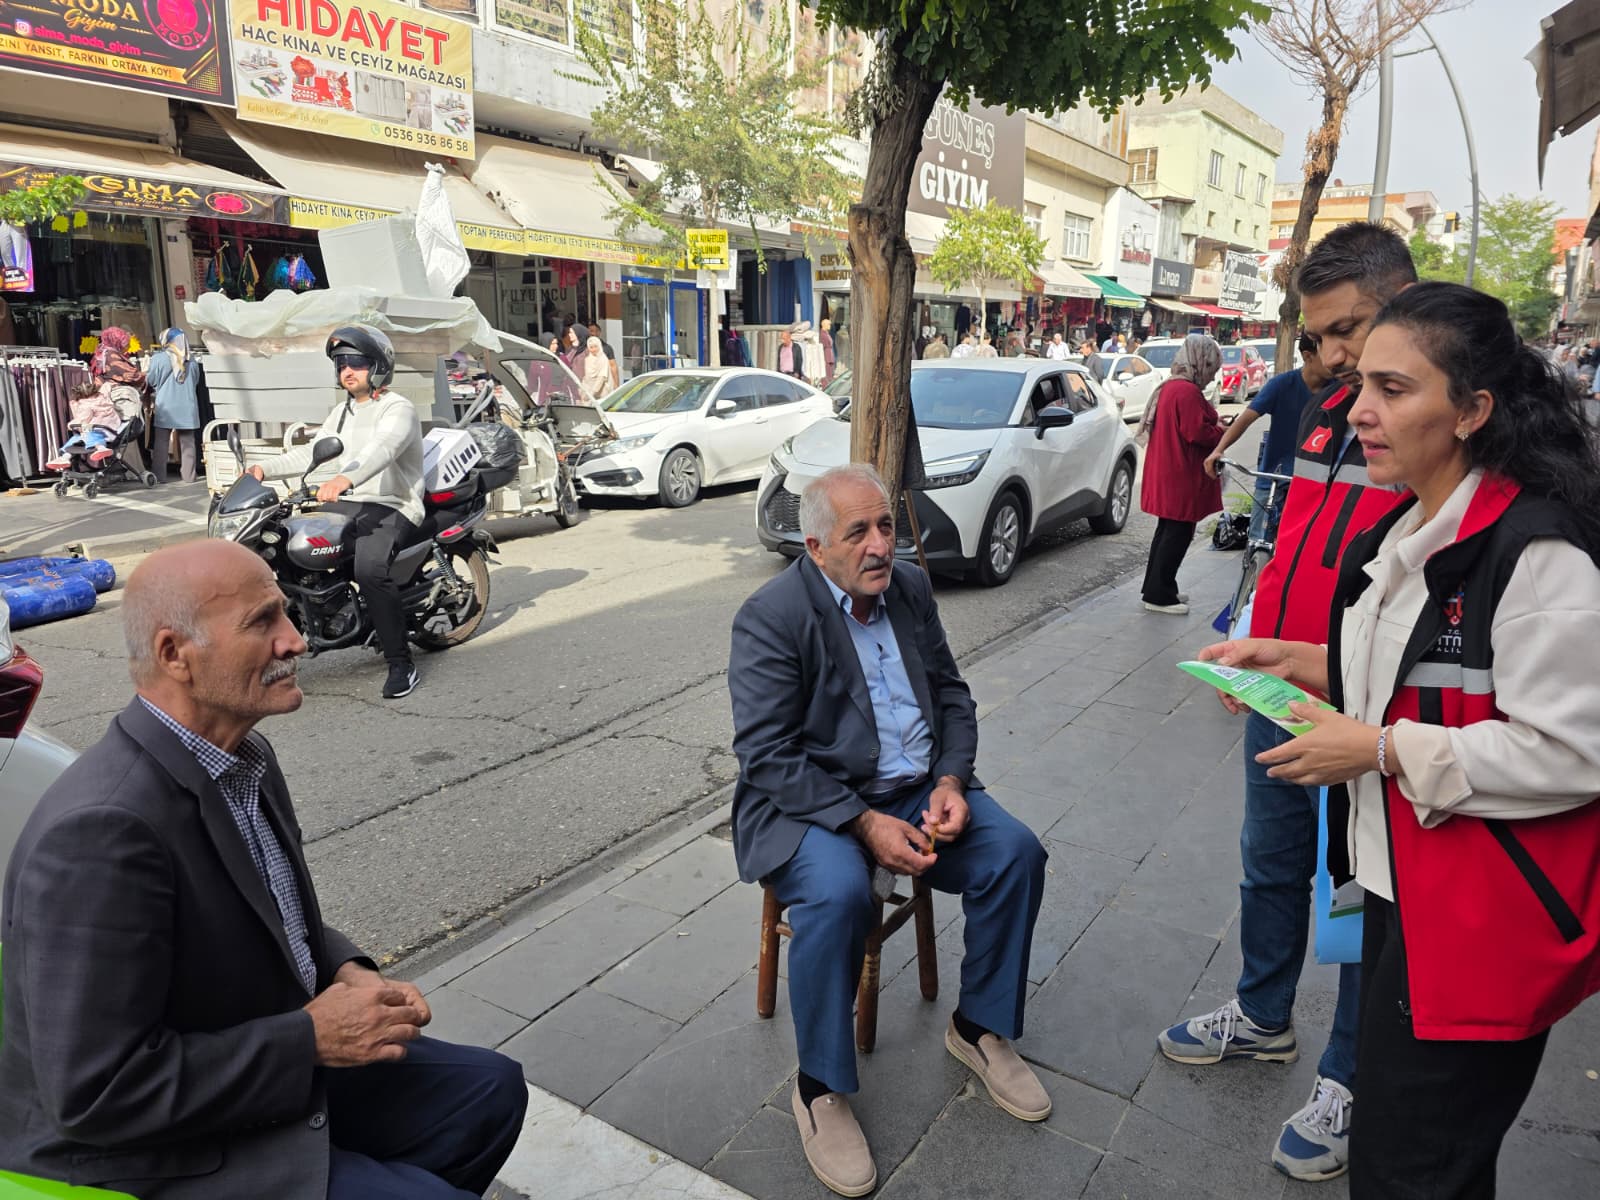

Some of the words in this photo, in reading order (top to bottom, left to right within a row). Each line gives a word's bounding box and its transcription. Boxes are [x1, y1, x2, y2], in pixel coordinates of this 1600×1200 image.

[63, 8, 117, 32] Giyim
[155, 22, 204, 45] MODA
[24, 42, 64, 58] YANSIT,
[68, 50, 108, 65] FARKINI
[112, 59, 148, 73] ORTAYA
[151, 65, 172, 78] KOY!
[242, 24, 278, 44] HAC
[283, 35, 322, 55] KINA
[326, 44, 347, 61] VE
[351, 51, 394, 73] ÇEYİZ
[398, 61, 466, 90] MAĞAZASI
[384, 126, 414, 142] 0536
[416, 132, 437, 147] 936
[440, 137, 453, 149] 86
[456, 140, 469, 152] 58
[101, 176, 201, 199] SİMA
[919, 150, 989, 211] GİYİM
[122, 191, 191, 205] MODA
[331, 206, 353, 219] KINA
[459, 224, 487, 237] TOPTAN
